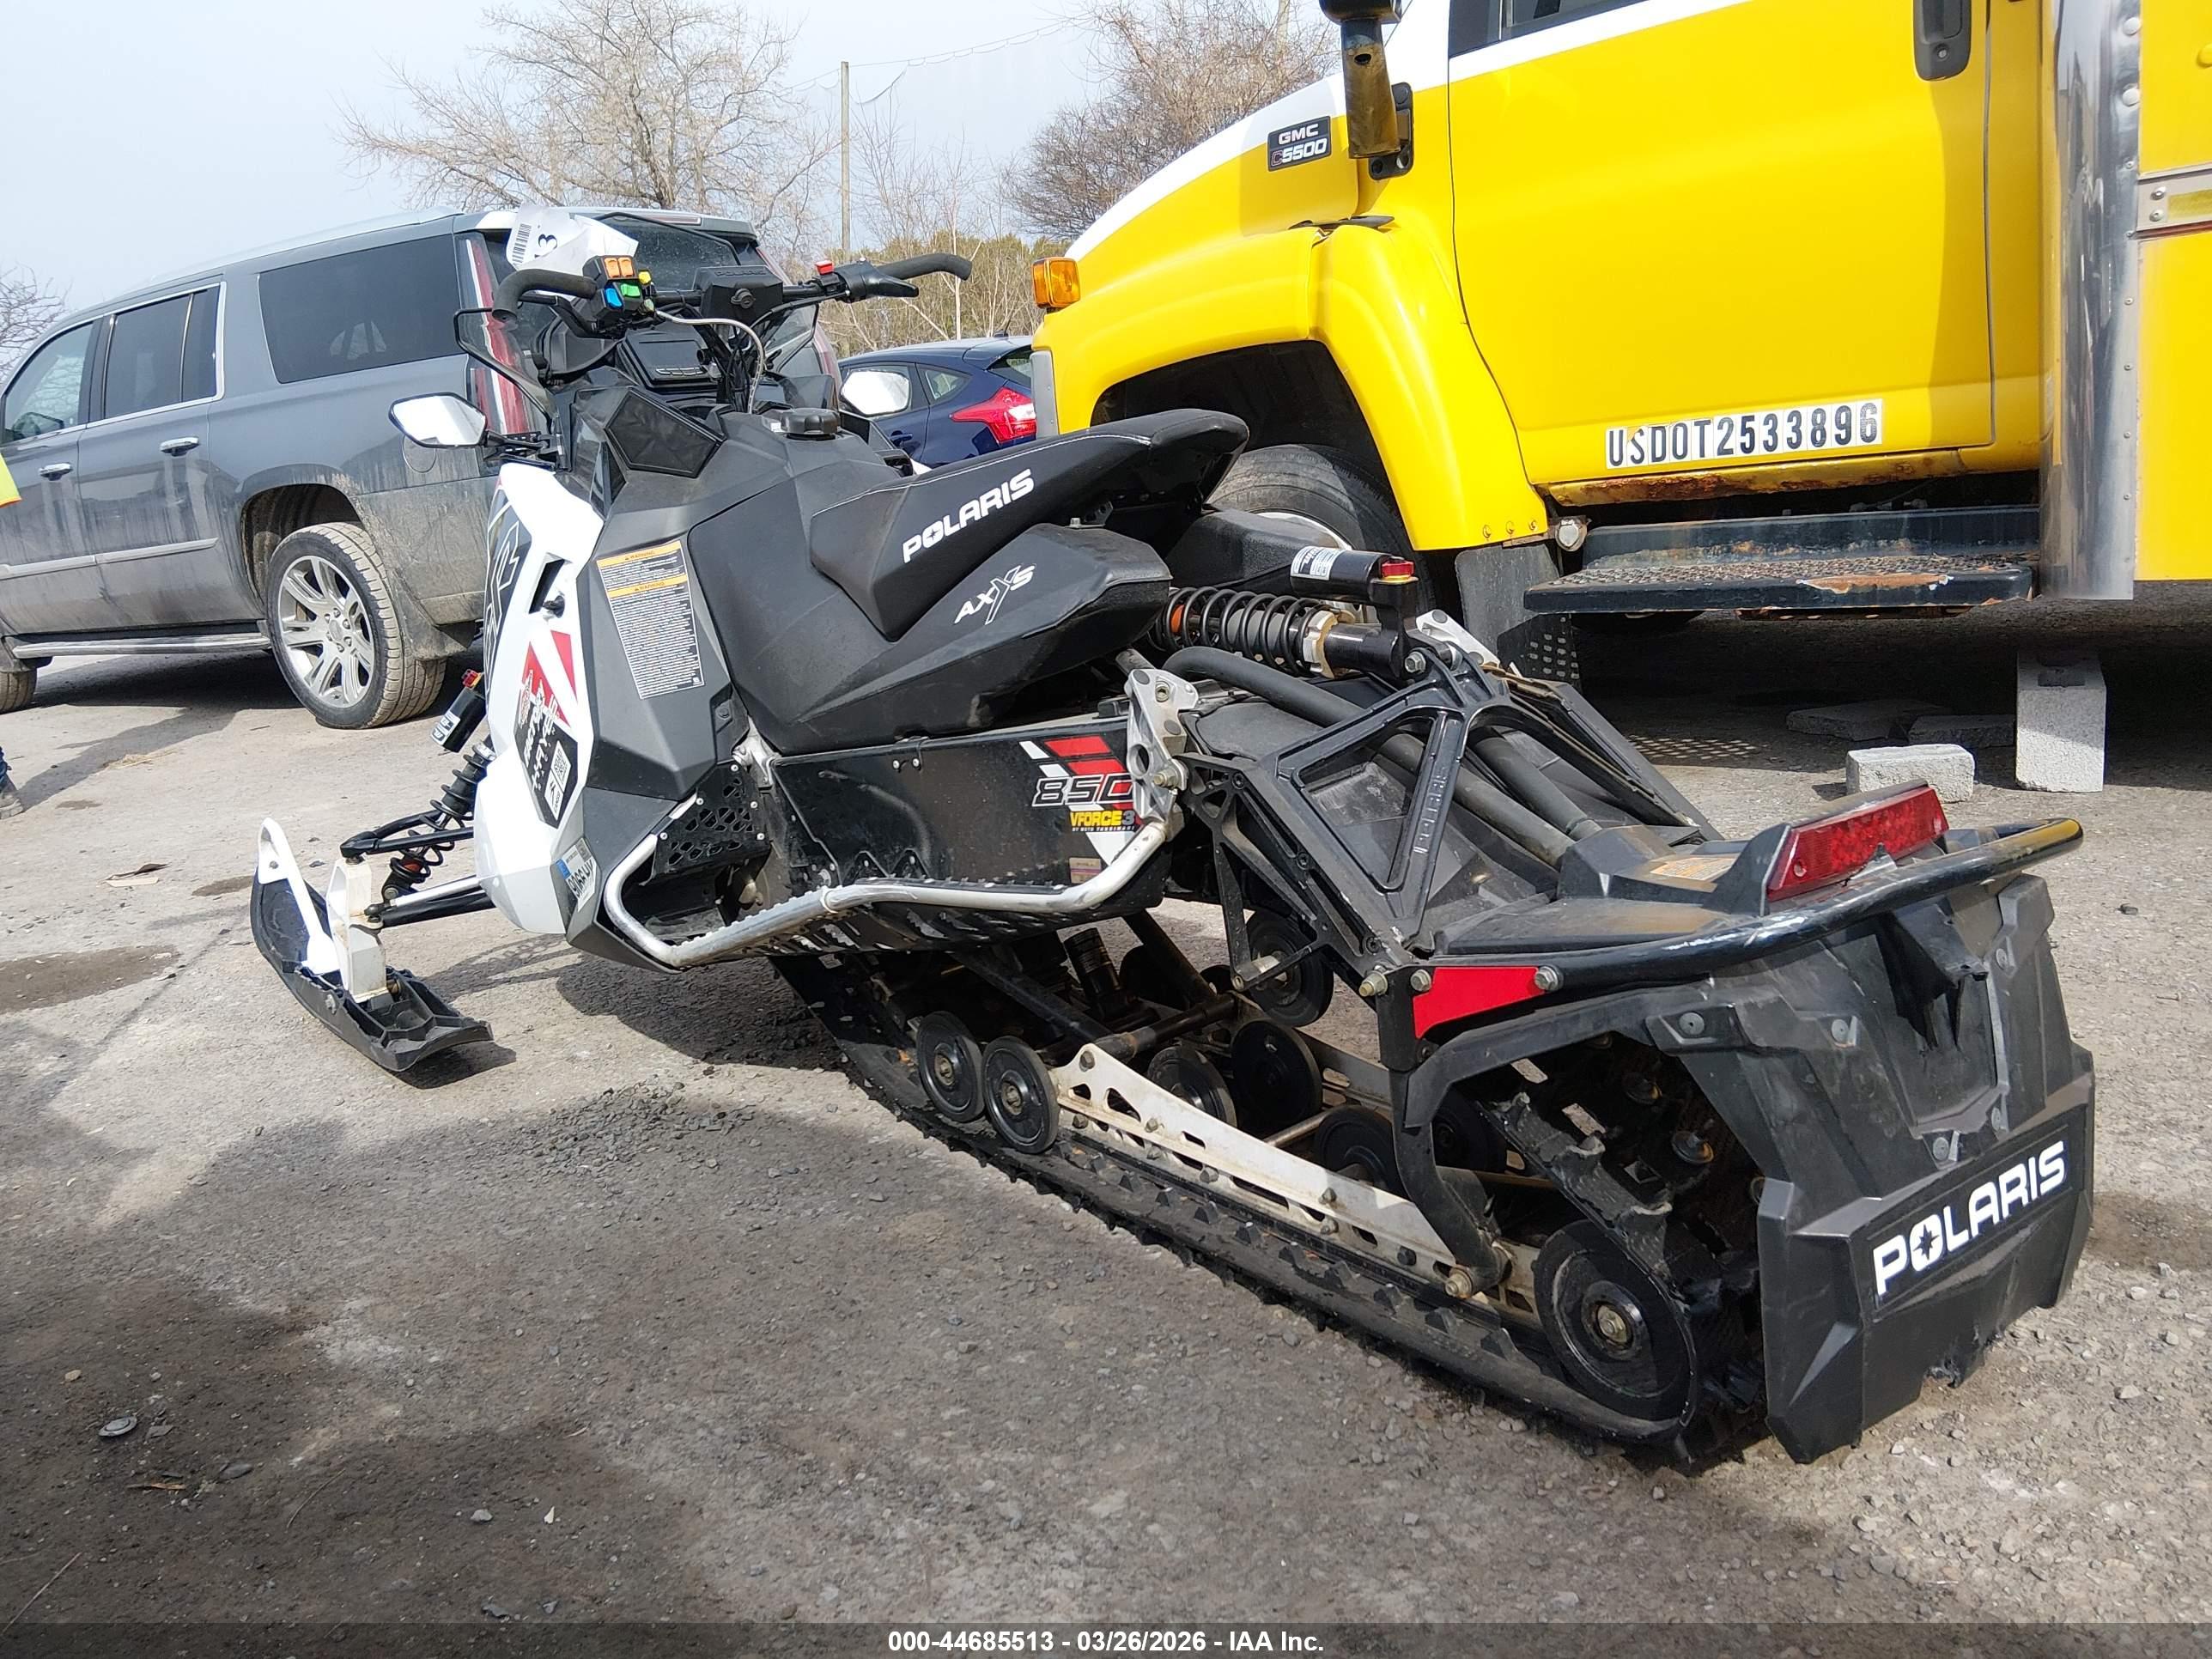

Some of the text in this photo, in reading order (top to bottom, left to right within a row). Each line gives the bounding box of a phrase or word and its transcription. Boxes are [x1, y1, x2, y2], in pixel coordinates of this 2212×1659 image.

[1271, 137, 1328, 167] C5500
[1279, 123, 1319, 145] GMC
[1608, 402, 1878, 467] USDOT2533896
[902, 468, 1035, 563] POLARIS
[954, 564, 1036, 625] AXYS
[1032, 773, 1133, 806] 850
[1873, 1140, 2065, 1297] POLARIS
